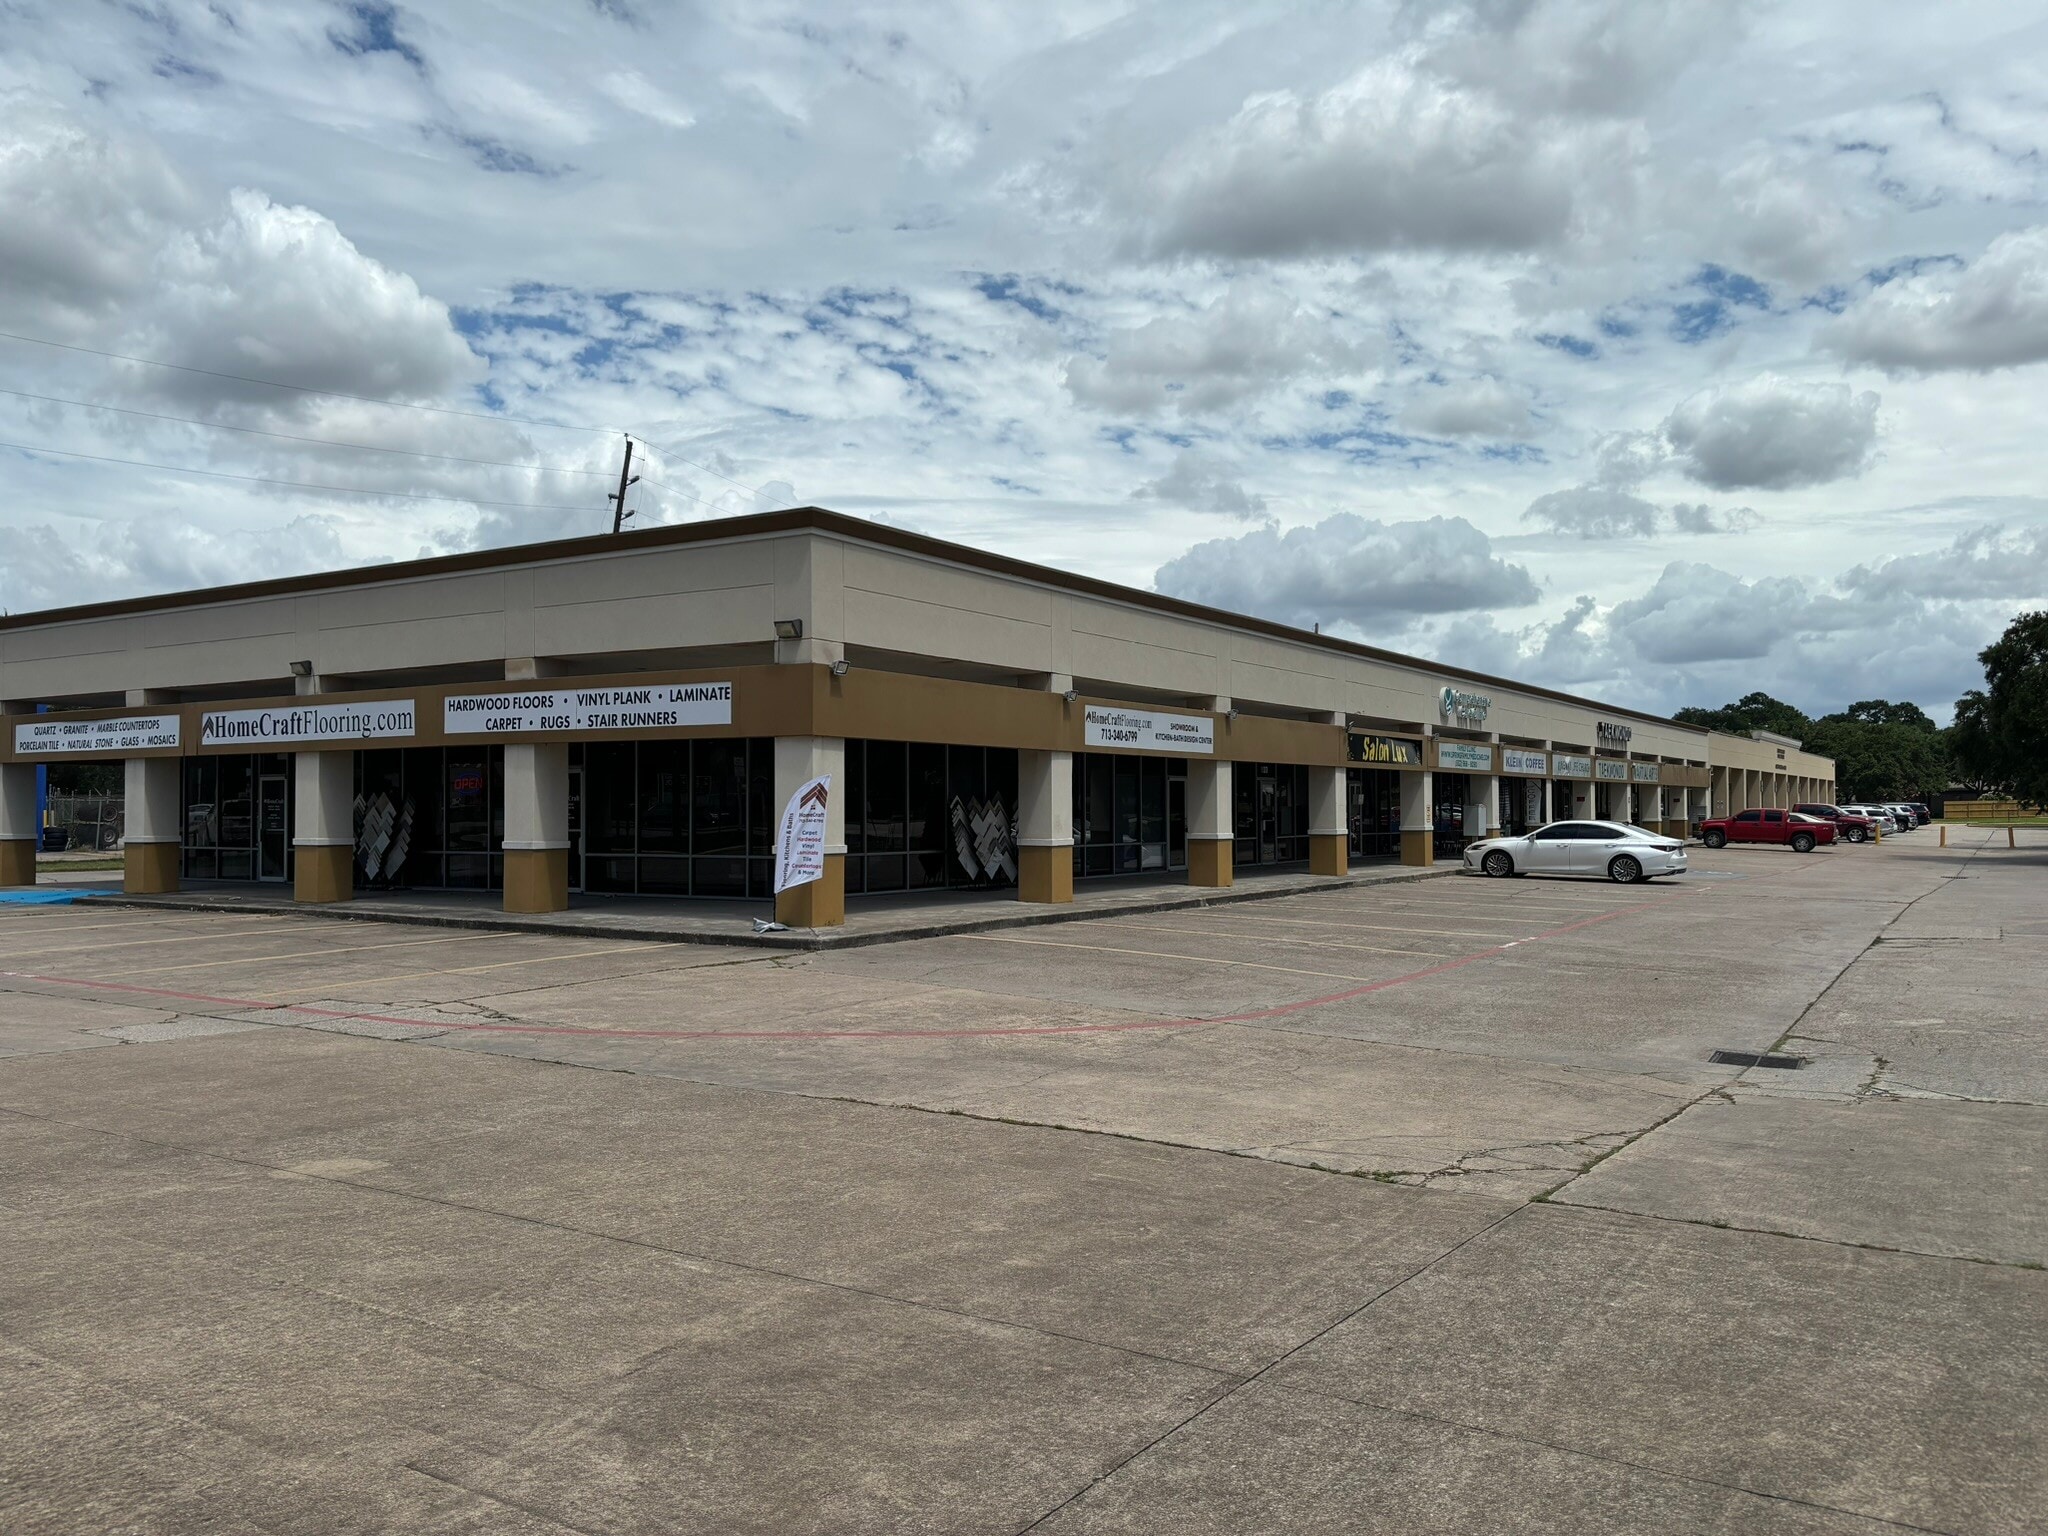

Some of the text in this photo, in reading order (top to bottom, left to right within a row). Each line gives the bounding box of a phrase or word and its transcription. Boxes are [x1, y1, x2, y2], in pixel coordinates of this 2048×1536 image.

[448, 686, 731, 712] HARDWOOD FLOORS VINYL PLANK LAMINATE
[34, 719, 160, 736] QUARTZ GRANITE MARBLE COUNTERTOPS
[214, 707, 413, 738] HomeCraftFlooring.com
[485, 711, 677, 730] CARPET RUGS STAIR RUNNERS
[19, 734, 176, 751] PORCELAIN TILE NATURAL STONE GLASS MOSAICS
[1101, 728, 1138, 742] 713-340-6799
[1362, 736, 1408, 763] Salon Lux
[1525, 757, 1545, 769] COFFEE
[454, 777, 484, 790] OPEN
